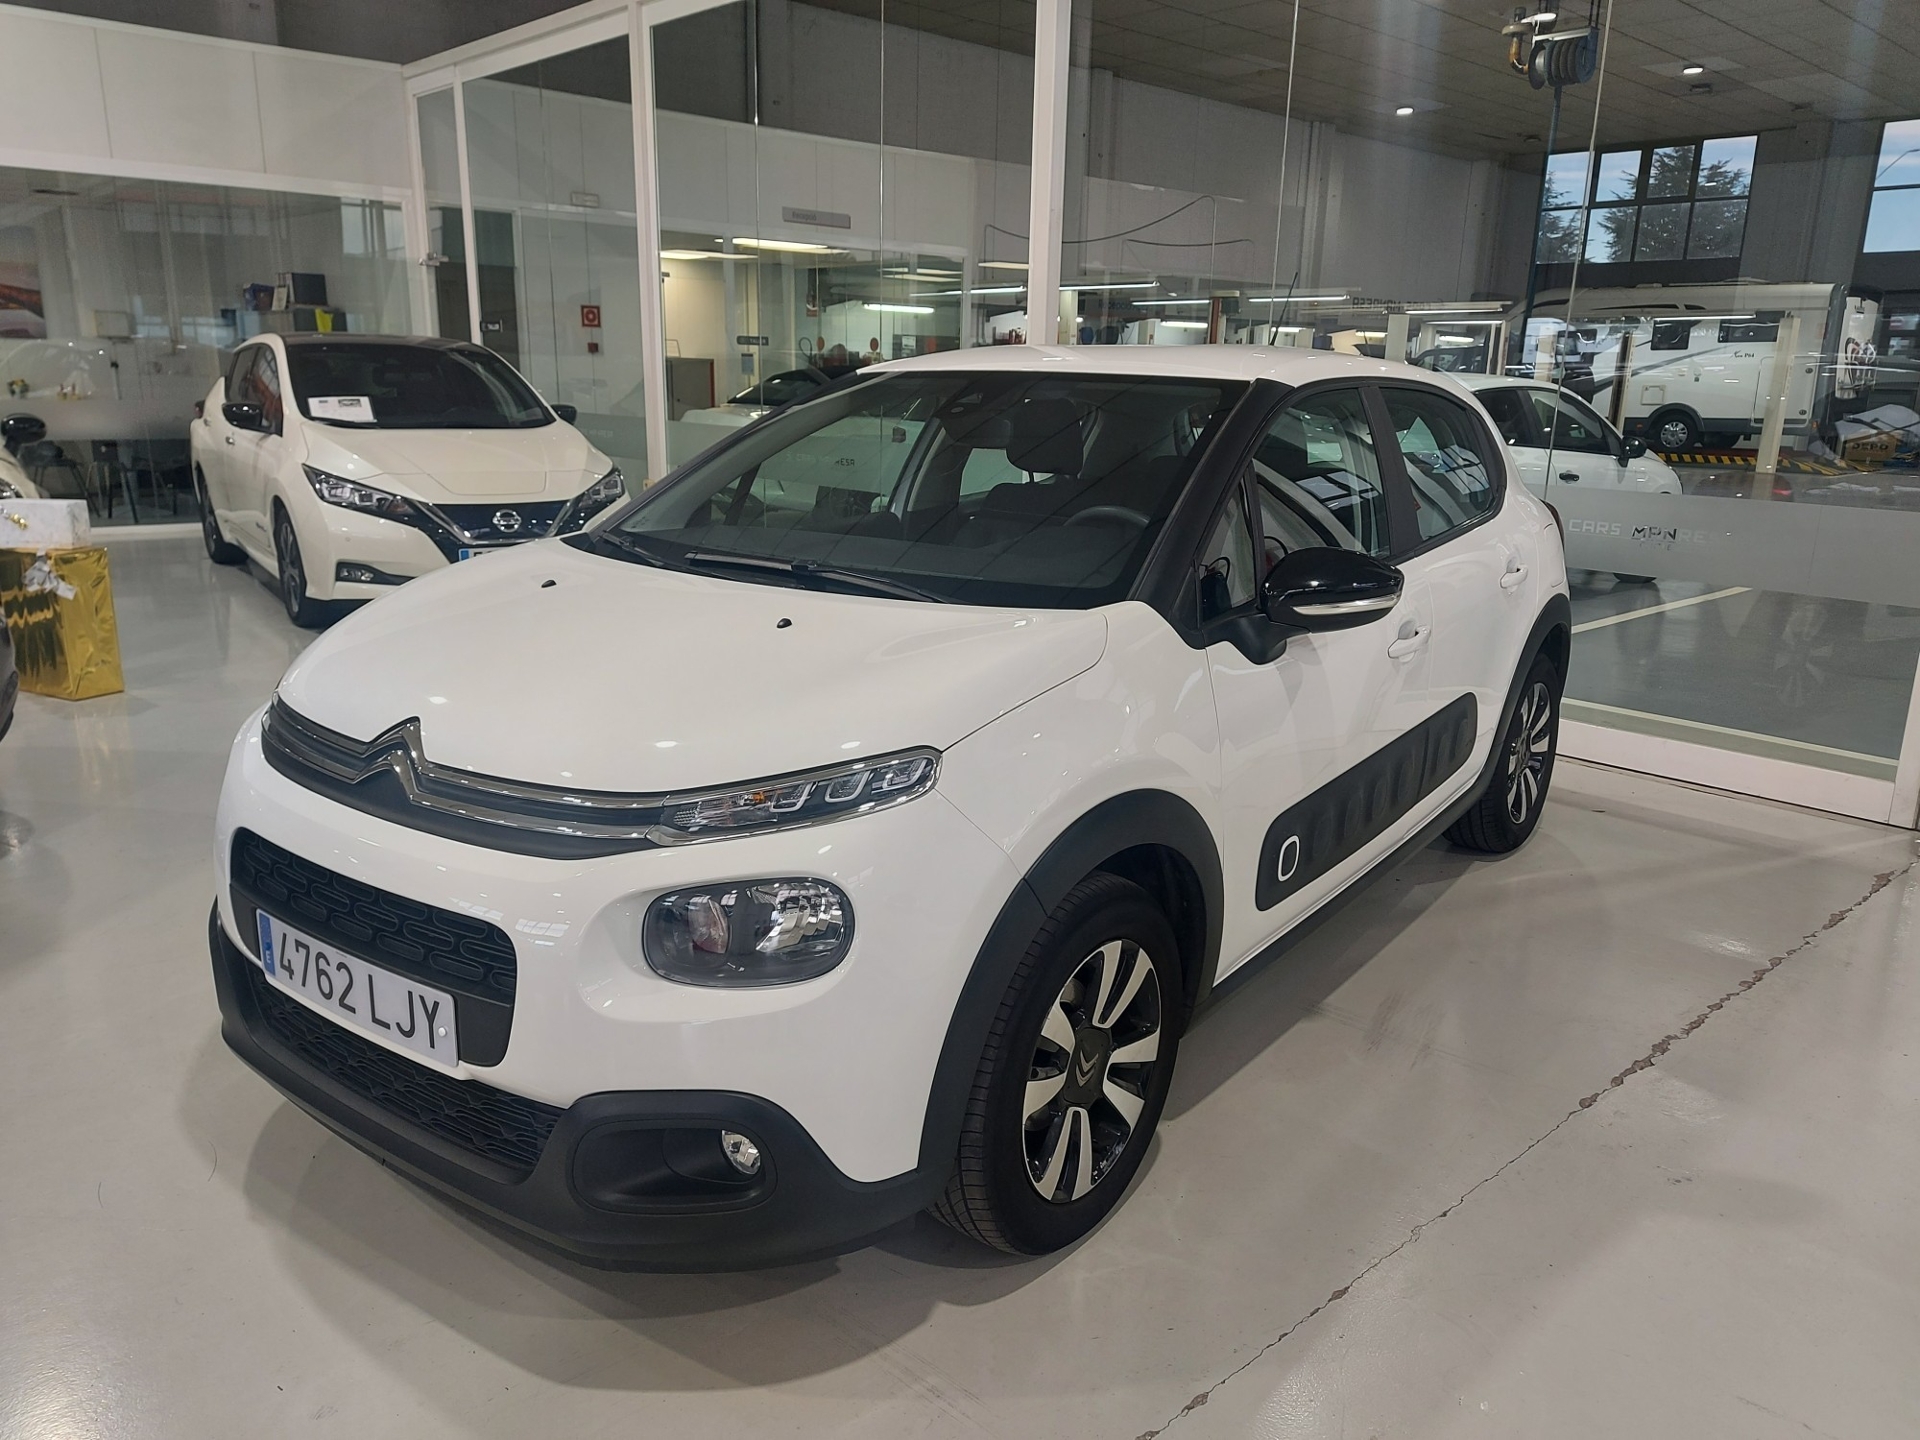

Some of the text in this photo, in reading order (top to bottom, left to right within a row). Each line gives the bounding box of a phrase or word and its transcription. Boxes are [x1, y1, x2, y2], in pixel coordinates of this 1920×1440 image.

[1568, 518, 1622, 536] CARS
[279, 932, 440, 1050] 4762 LJY
